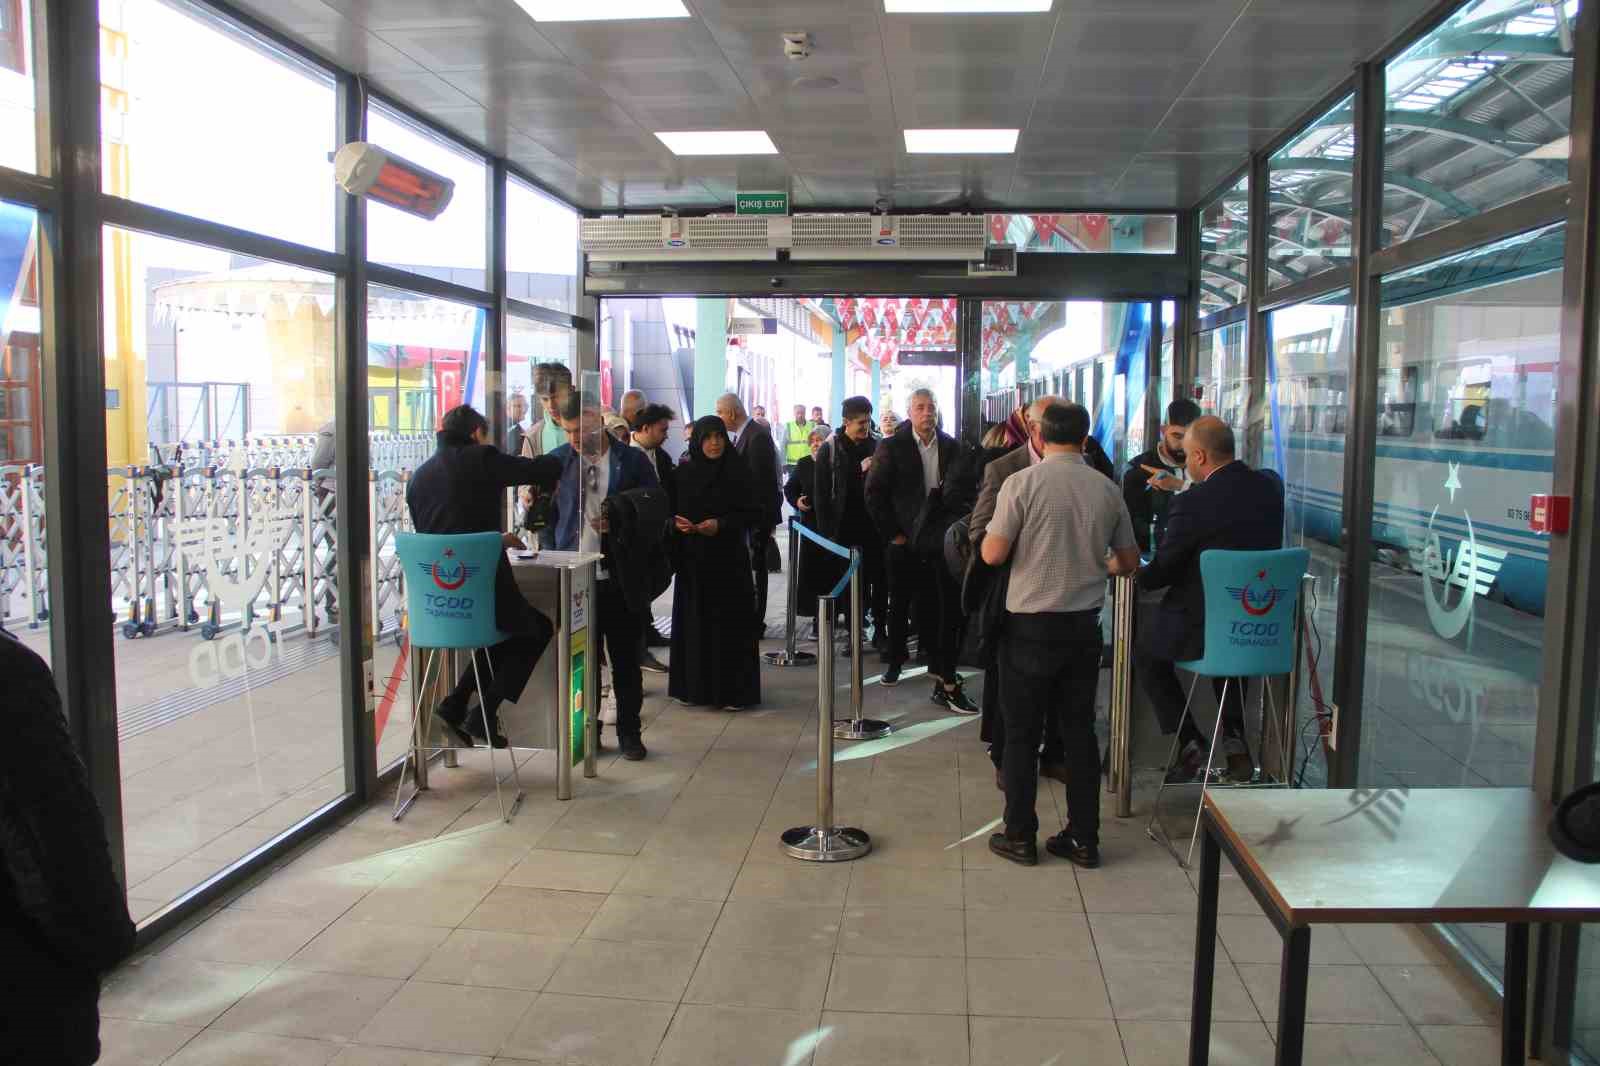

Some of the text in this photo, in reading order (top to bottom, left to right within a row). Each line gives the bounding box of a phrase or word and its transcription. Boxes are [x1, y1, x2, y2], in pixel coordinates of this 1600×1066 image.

[740, 199, 784, 209] ÇIKIŞ EXIT
[424, 593, 474, 609] TCDD
[1230, 621, 1280, 636] TCDD
